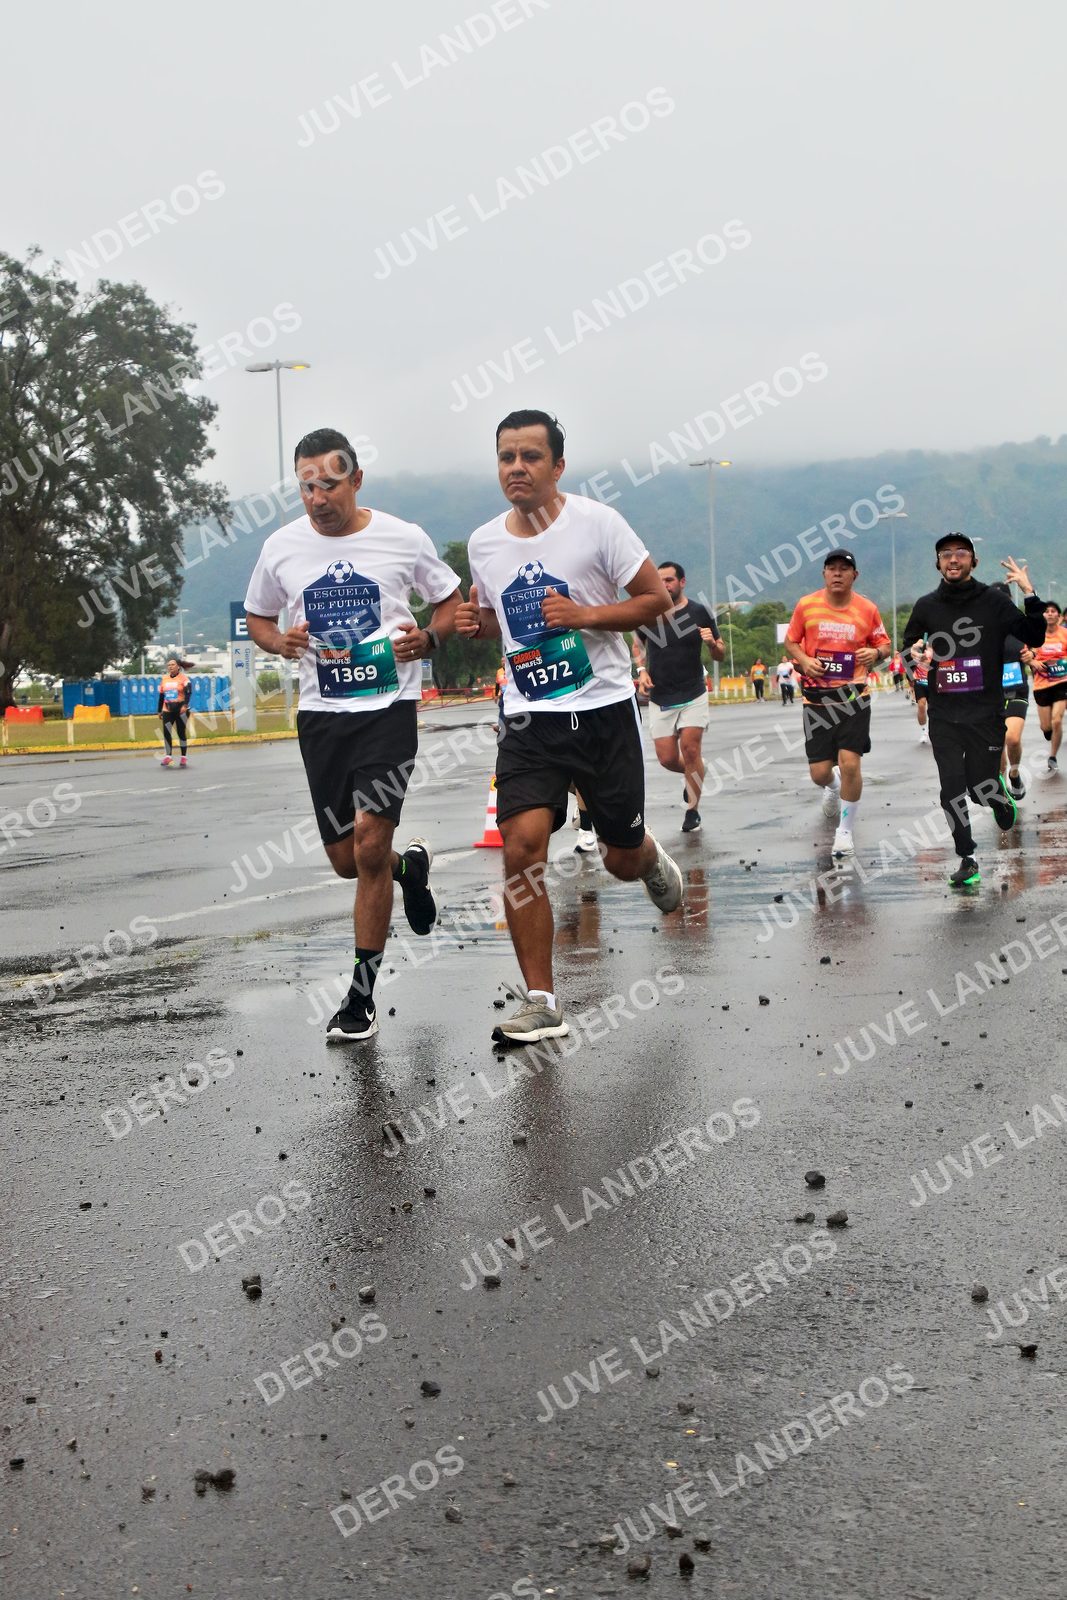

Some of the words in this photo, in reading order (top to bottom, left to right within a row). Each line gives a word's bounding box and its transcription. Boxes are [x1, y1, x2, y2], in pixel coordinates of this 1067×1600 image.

[313, 587, 370, 599] ESCUELA
[308, 601, 325, 611] DE
[329, 597, 378, 609] FÚTBOL
[507, 606, 523, 615] DE
[372, 642, 386, 656] 10K
[561, 636, 577, 652] 10K
[330, 664, 378, 683] 1369
[526, 661, 573, 687] 1372
[824, 662, 843, 672] 755
[946, 672, 968, 683] 363
